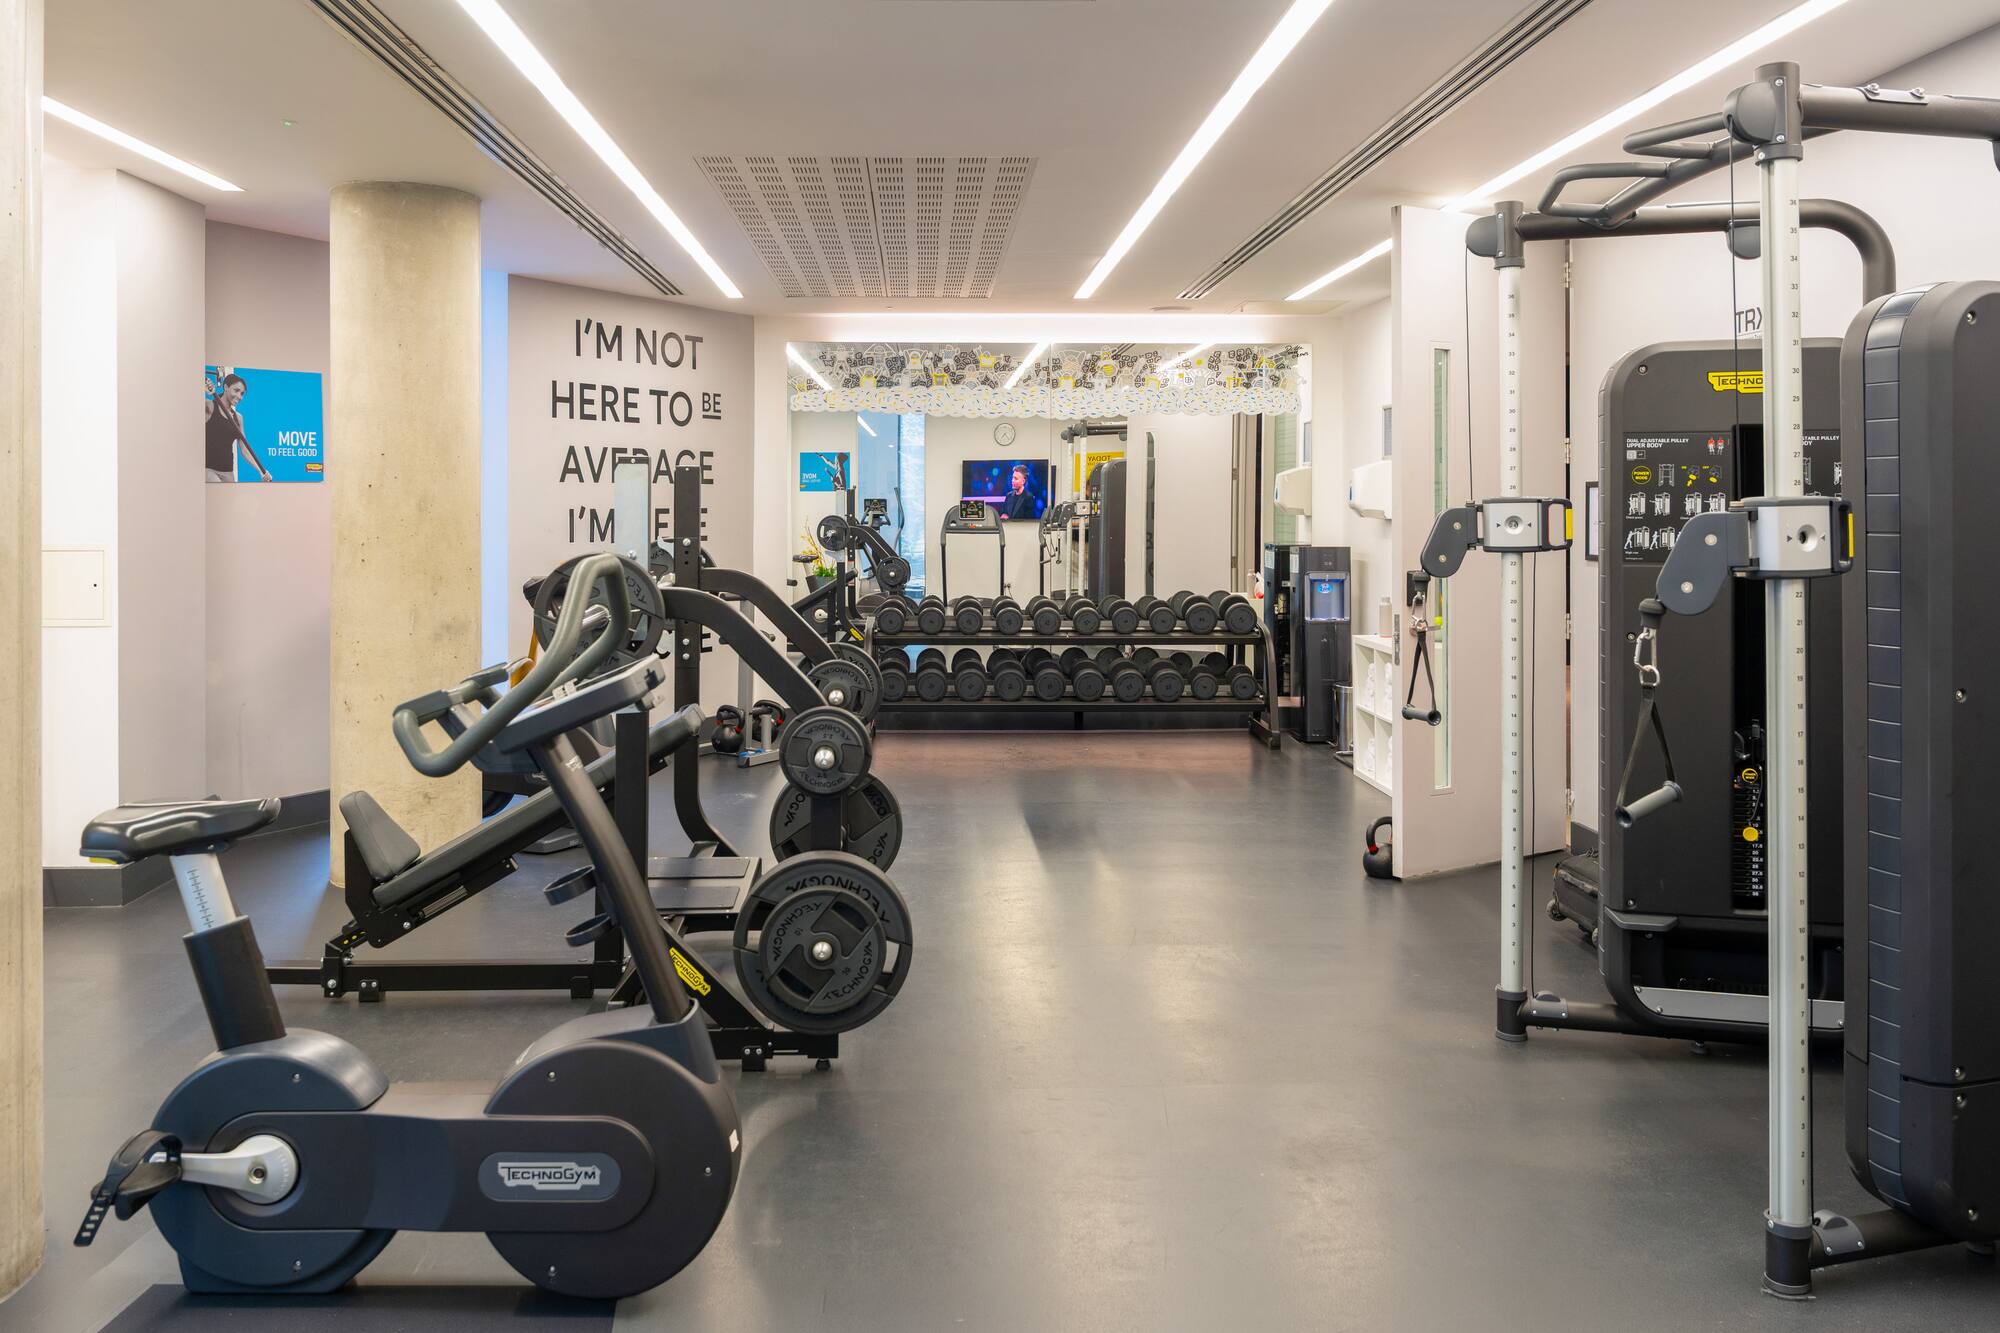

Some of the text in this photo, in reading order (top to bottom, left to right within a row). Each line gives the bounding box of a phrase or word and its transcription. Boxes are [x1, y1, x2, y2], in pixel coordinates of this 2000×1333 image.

[575, 318, 703, 370] I'M NOT
[1712, 374, 1763, 388] TECHNO
[551, 380, 722, 427] HERE TO BE
[268, 448, 318, 456] TO FEEL GOOD
[278, 431, 317, 446] MOVE
[559, 445, 714, 484] AVAE
[785, 875, 890, 925] TECHNOGYM
[771, 901, 823, 962] TECHNOGYM
[821, 940, 872, 1001] TECHNOGYM
[500, 1166, 596, 1184] TECHNOGYM
